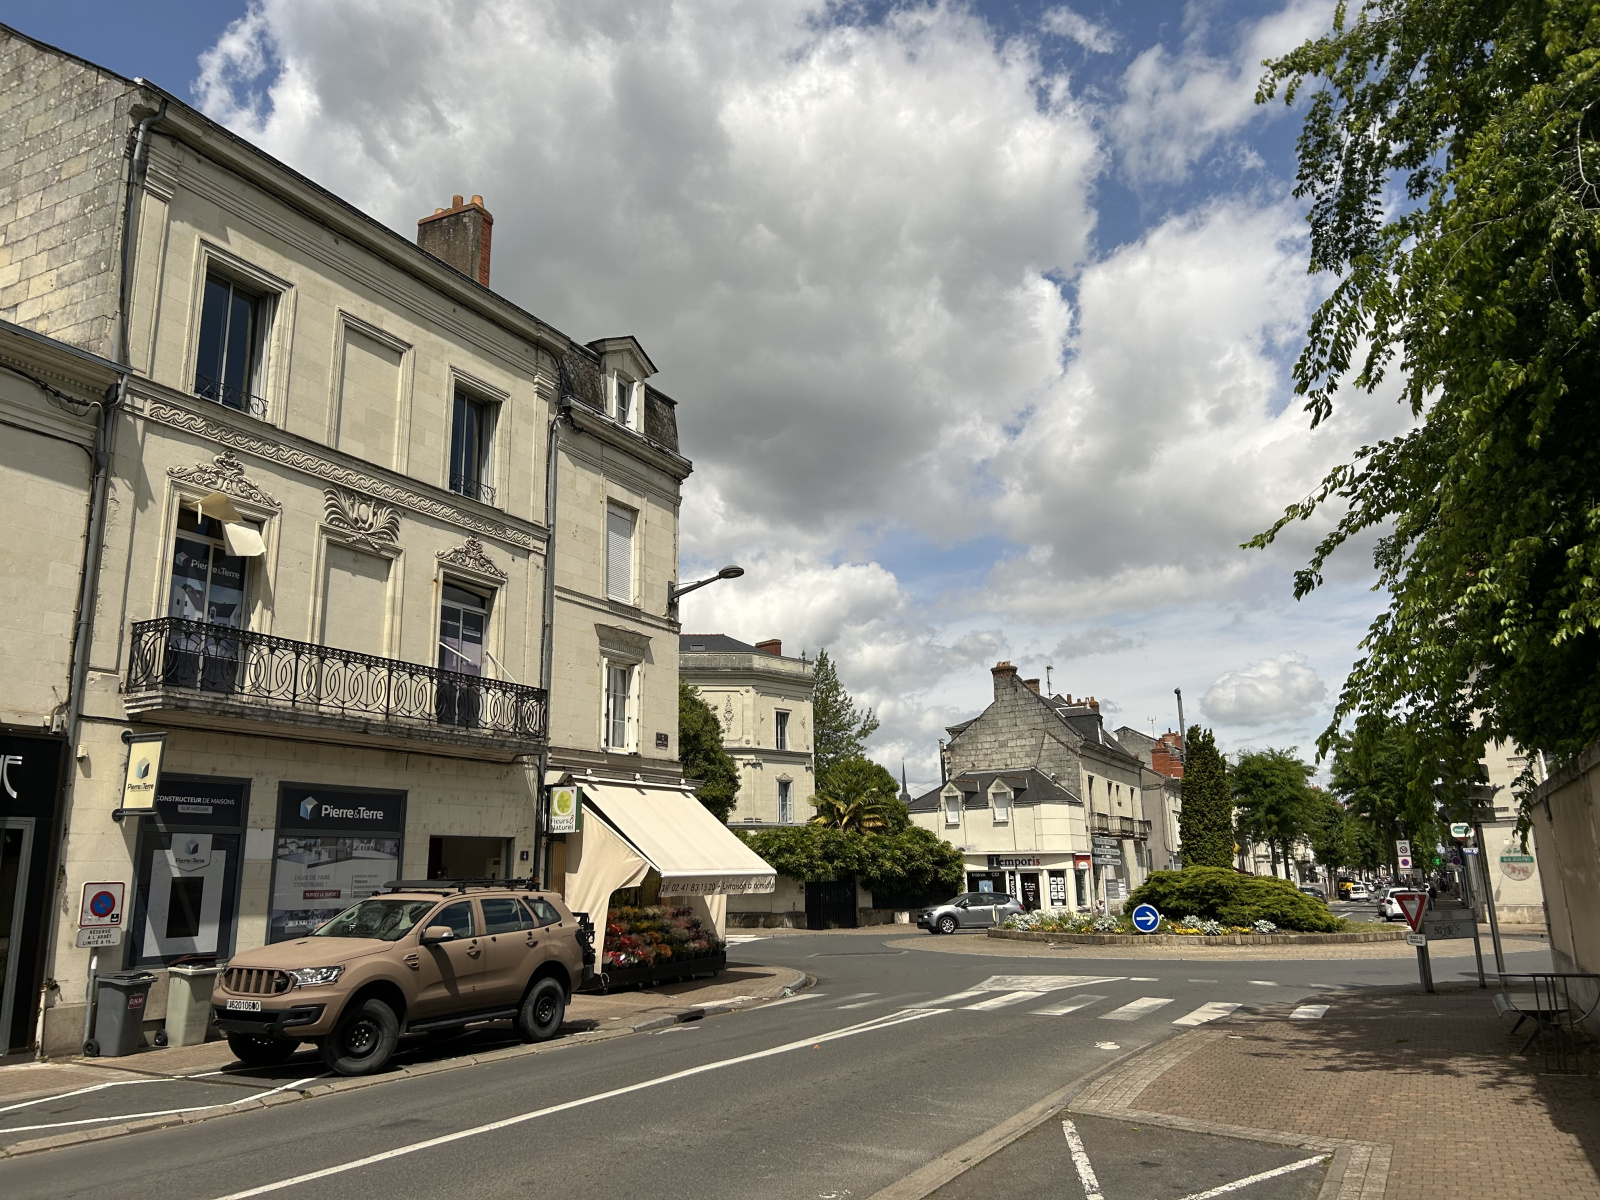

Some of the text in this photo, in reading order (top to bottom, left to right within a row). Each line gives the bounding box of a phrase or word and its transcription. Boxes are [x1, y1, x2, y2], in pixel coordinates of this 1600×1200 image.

[191, 559, 240, 578] Piere&Terre
[321, 804, 384, 819] Pierre&Terre
[990, 856, 1040, 868] Temporis
